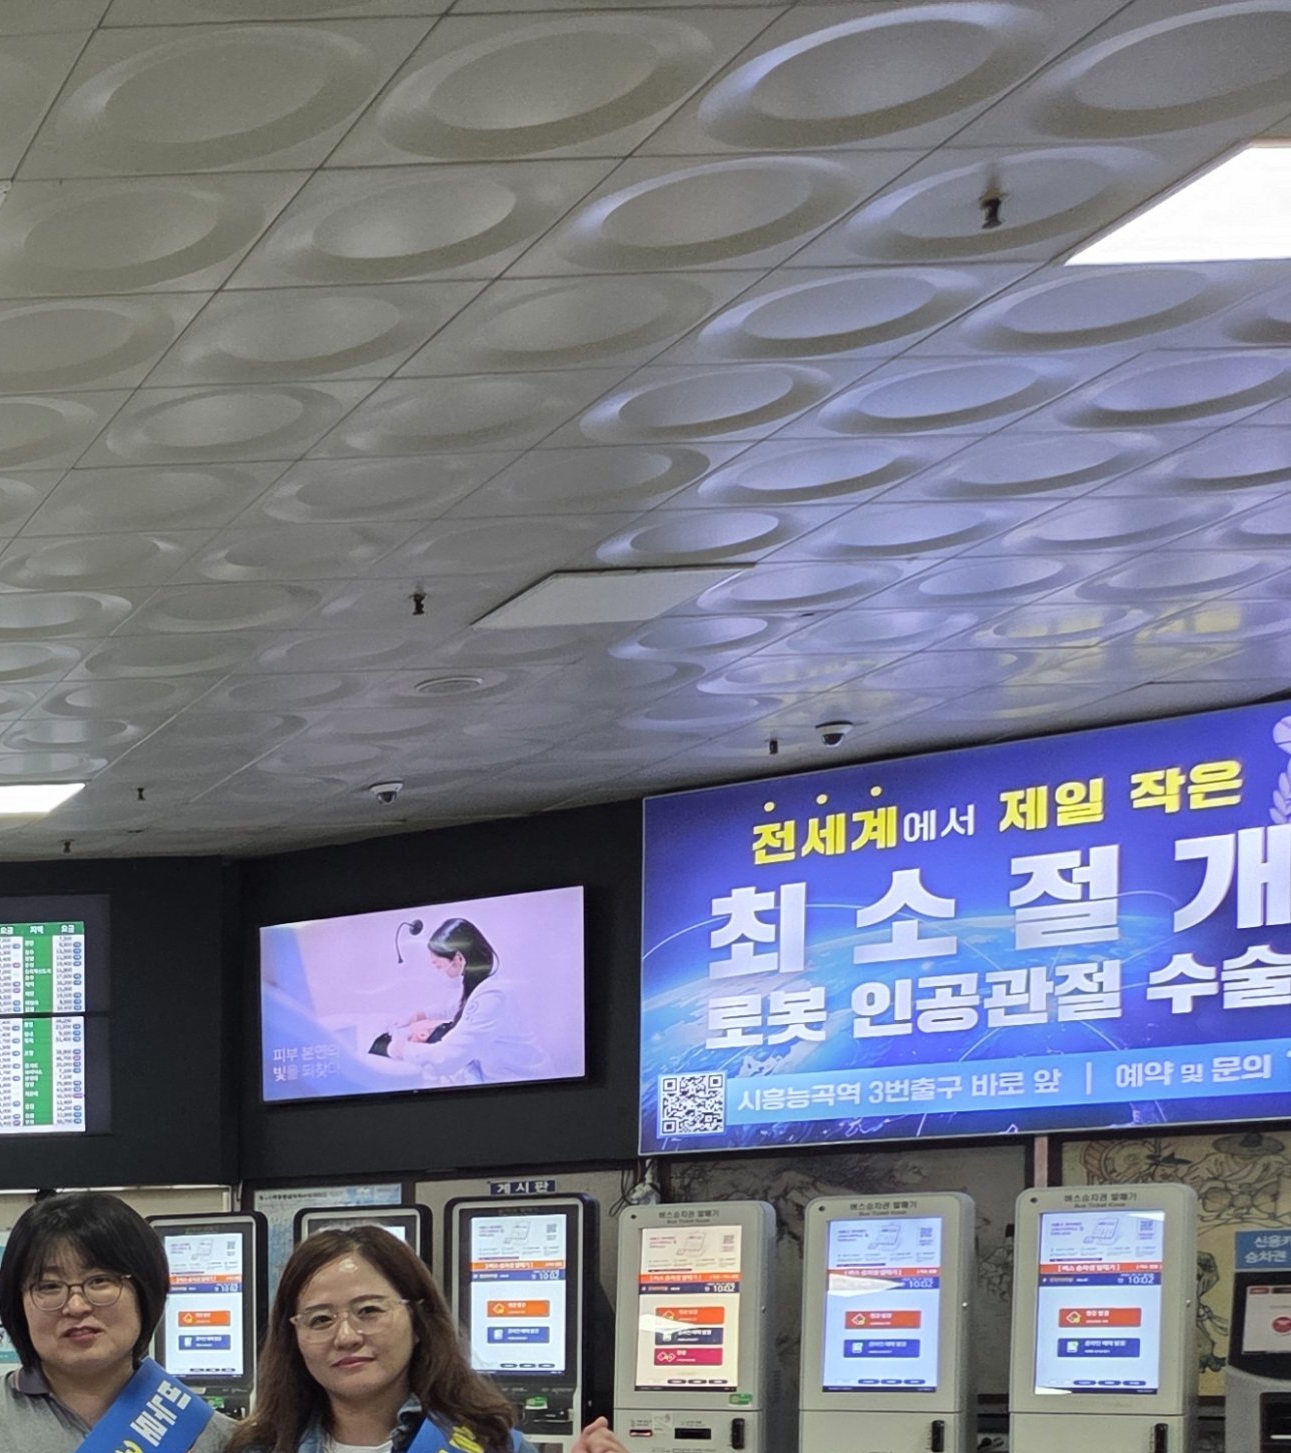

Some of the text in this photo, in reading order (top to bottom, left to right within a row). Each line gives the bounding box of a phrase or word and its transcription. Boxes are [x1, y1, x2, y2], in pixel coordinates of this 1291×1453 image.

[751, 758, 1244, 866] 전세계에서 제일 작은
[705, 943, 1291, 1051] 로봇 인공관절 수술
[273, 1047, 298, 1063] 피부
[738, 1053, 1273, 1113] 시흥능곡역 3번출구 바로 앞 예약 및 문의
[496, 1180, 551, 1193] 게시판
[130, 1380, 192, 1448] 비누로
